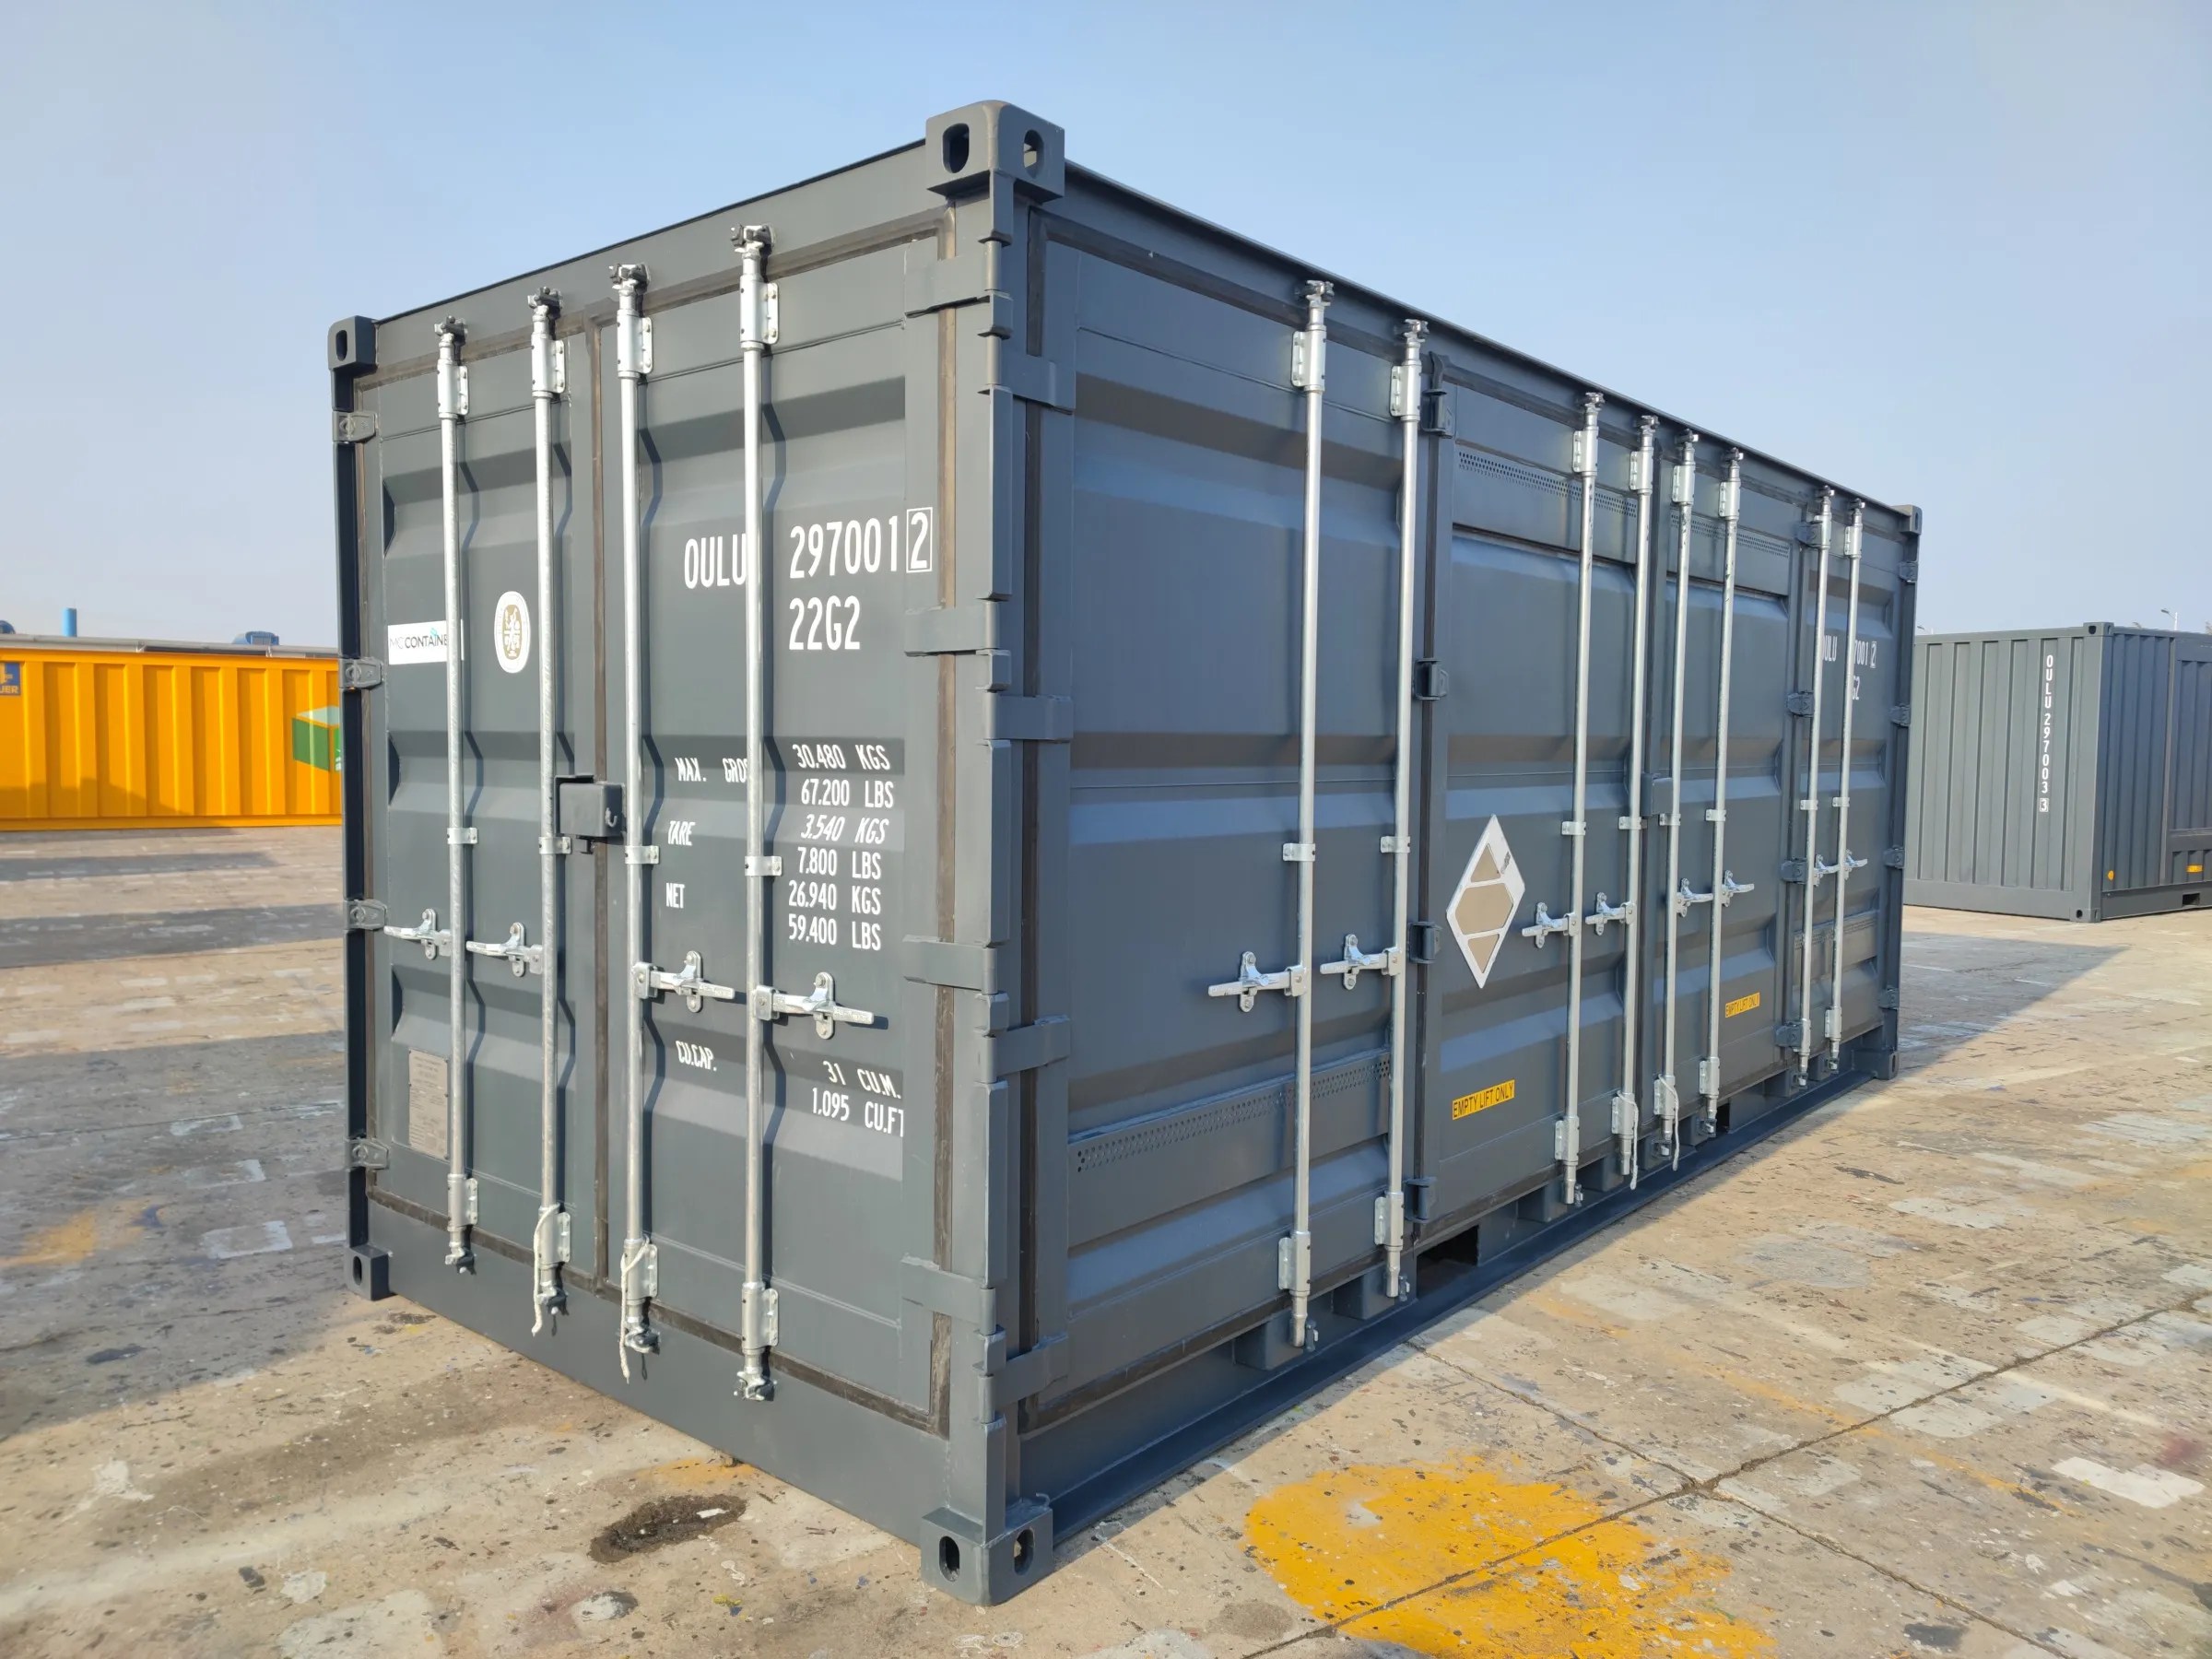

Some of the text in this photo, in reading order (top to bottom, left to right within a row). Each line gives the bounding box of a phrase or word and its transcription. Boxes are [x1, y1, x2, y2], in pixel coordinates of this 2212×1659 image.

[684, 533, 747, 589] OULU
[789, 595, 861, 651] 22G2
[2044, 654, 2054, 709] OULU
[675, 744, 890, 783] MAX. GRO 30.480 KGS
[801, 779, 894, 809] 67.200 LBS
[668, 814, 889, 847] TARE 3.540 KGS
[797, 846, 881, 880] 7.800 LBS
[665, 880, 881, 915] NET 26.940 KGS
[788, 913, 881, 951] 59.400 LBS
[823, 1060, 846, 1086] 31
[812, 1087, 849, 1122] 1.095
[1453, 1082, 1514, 1118] EMPTY LIFT ONLY
